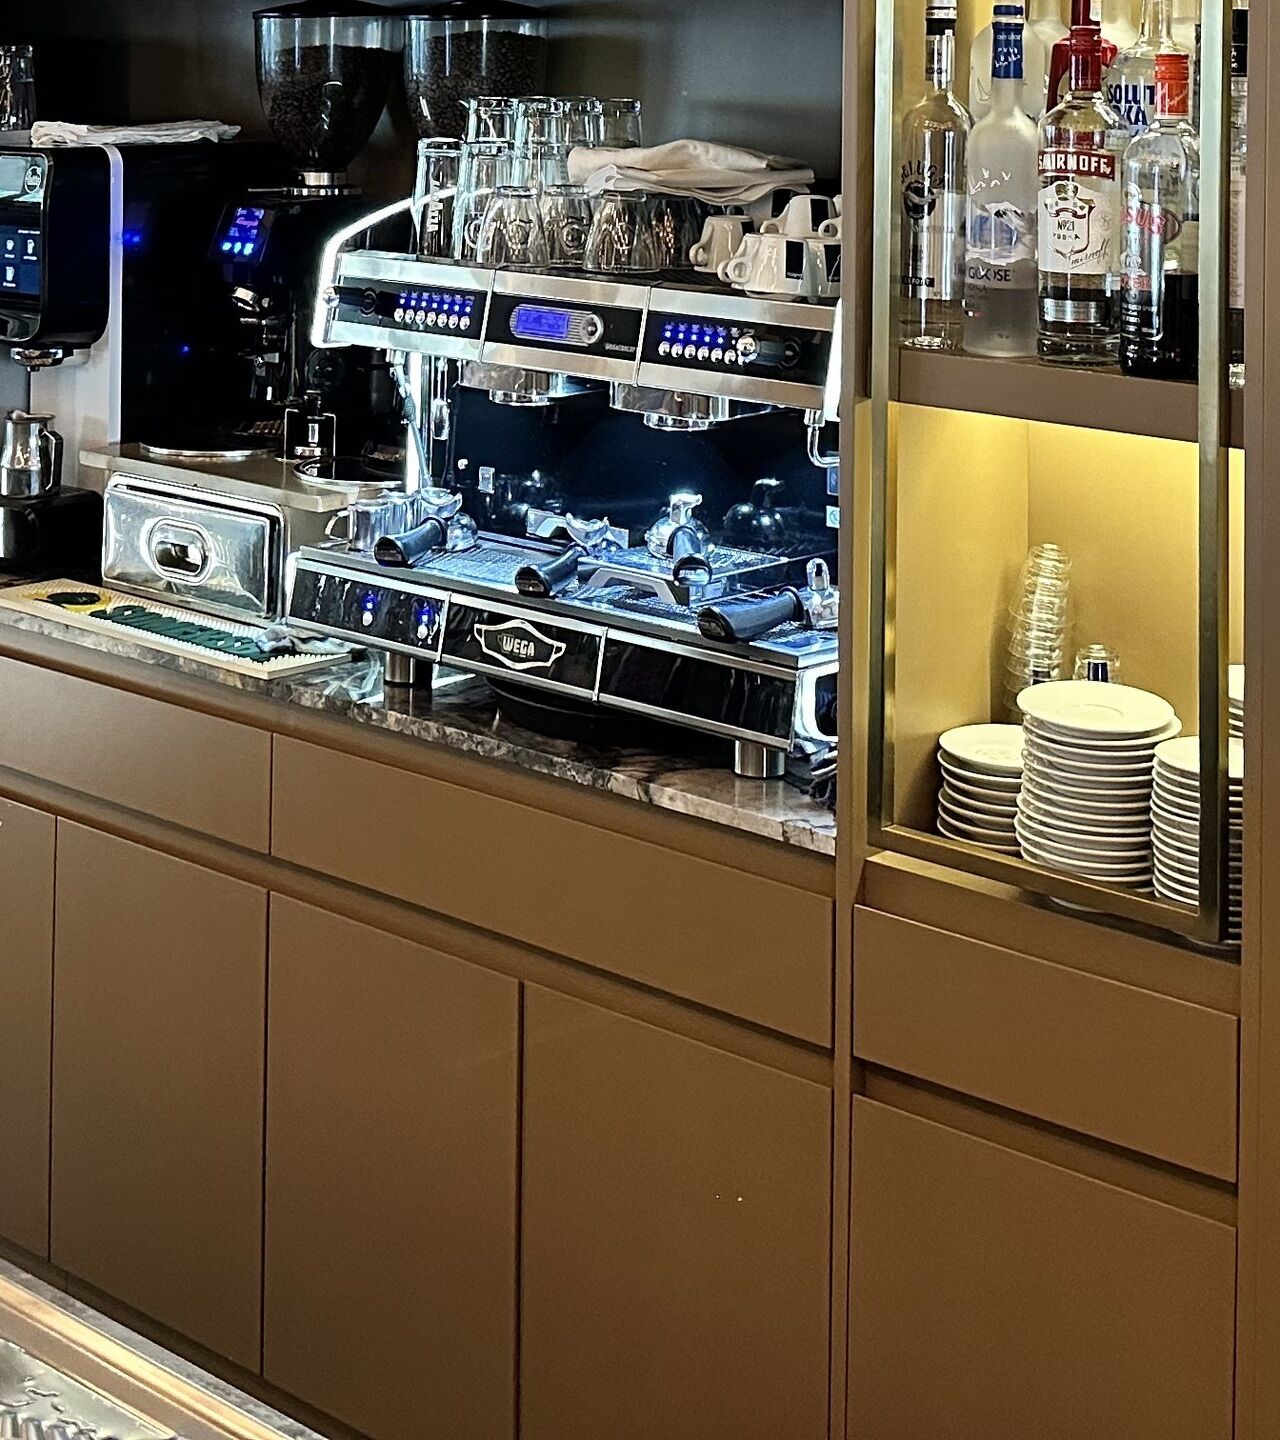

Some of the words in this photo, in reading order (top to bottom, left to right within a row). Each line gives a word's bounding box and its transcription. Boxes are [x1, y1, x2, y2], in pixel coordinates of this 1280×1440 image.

[1108, 84, 1156, 107] SOLUT
[1038, 154, 1109, 174] SMIRNOFF
[90, 604, 275, 664] SOMERSB
[502, 635, 535, 658] WEGA
